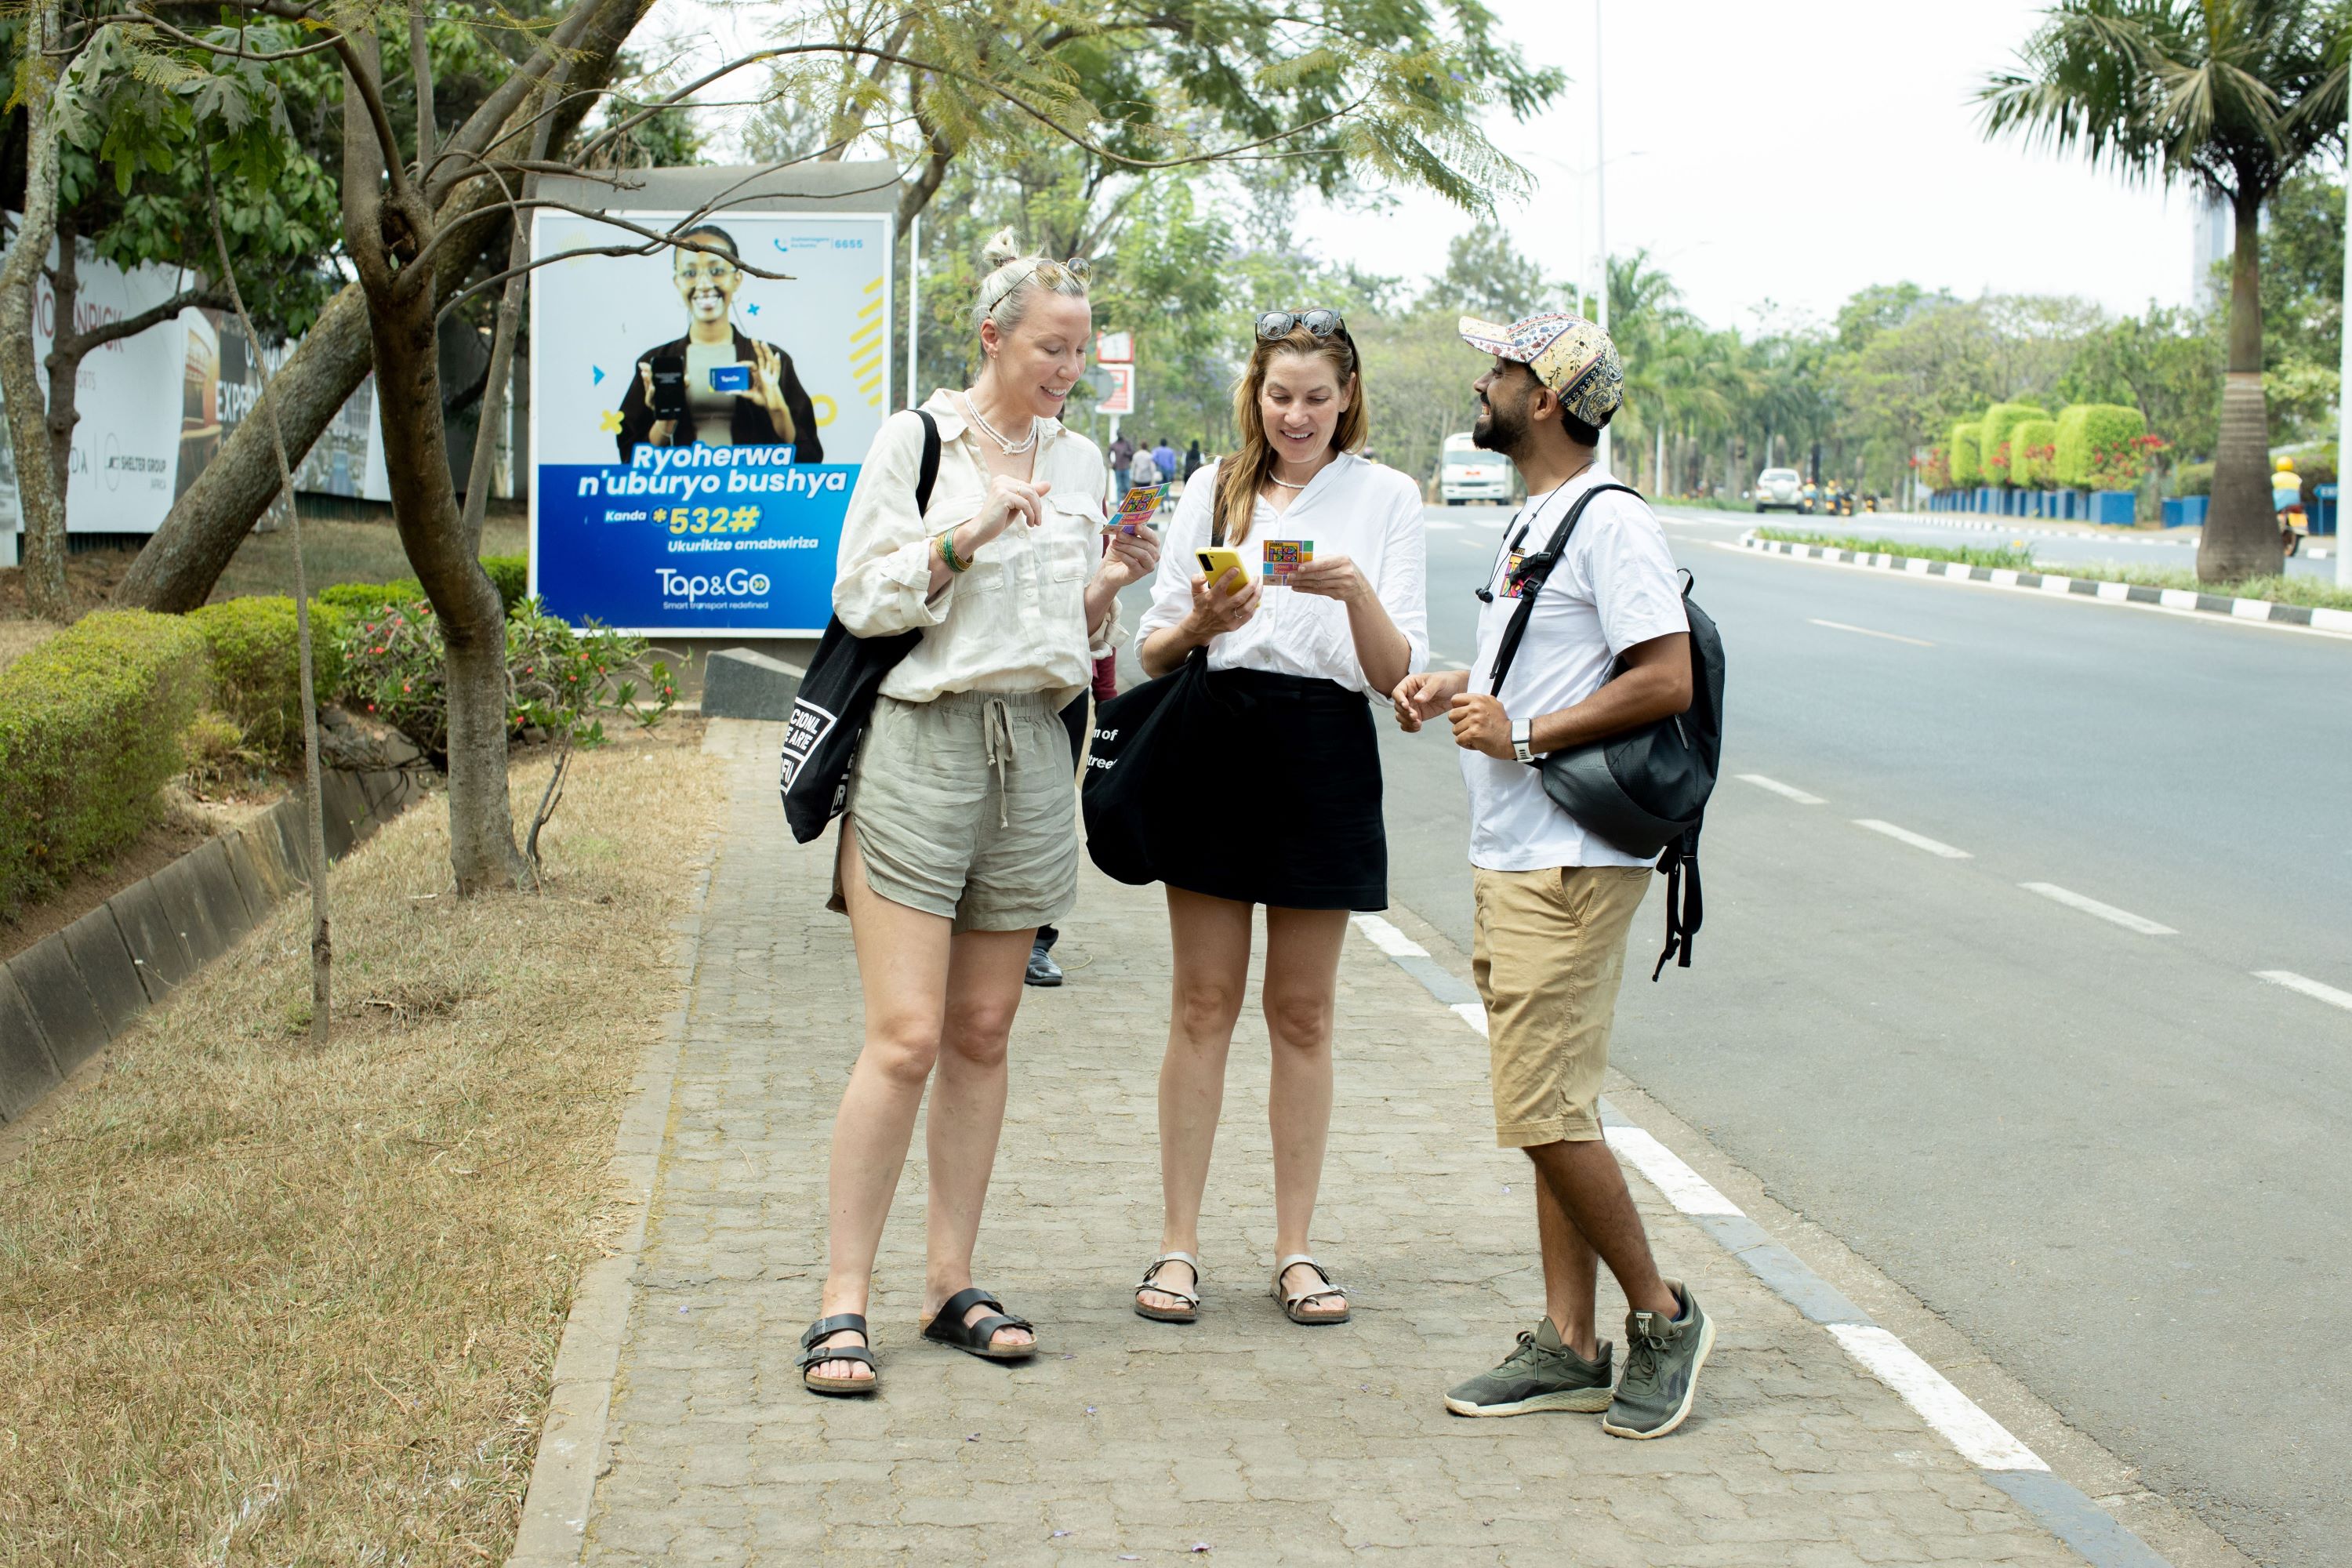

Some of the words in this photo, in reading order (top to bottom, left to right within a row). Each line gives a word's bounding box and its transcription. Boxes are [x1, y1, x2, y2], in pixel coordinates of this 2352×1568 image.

[633, 444, 793, 475] Ryoherwa
[577, 470, 720, 501] n'uburyo
[727, 468, 848, 499] bushya
[604, 510, 647, 523] Kanda
[667, 539, 732, 553] Ukurikize
[735, 536, 818, 550] amabwiriza
[655, 568, 771, 602] Tap&Go
[663, 601, 688, 610] Smart
[690, 601, 728, 612] transport
[729, 601, 769, 610] redefined
[1102, 729, 1119, 741] of
[1087, 754, 1118, 770] tree
